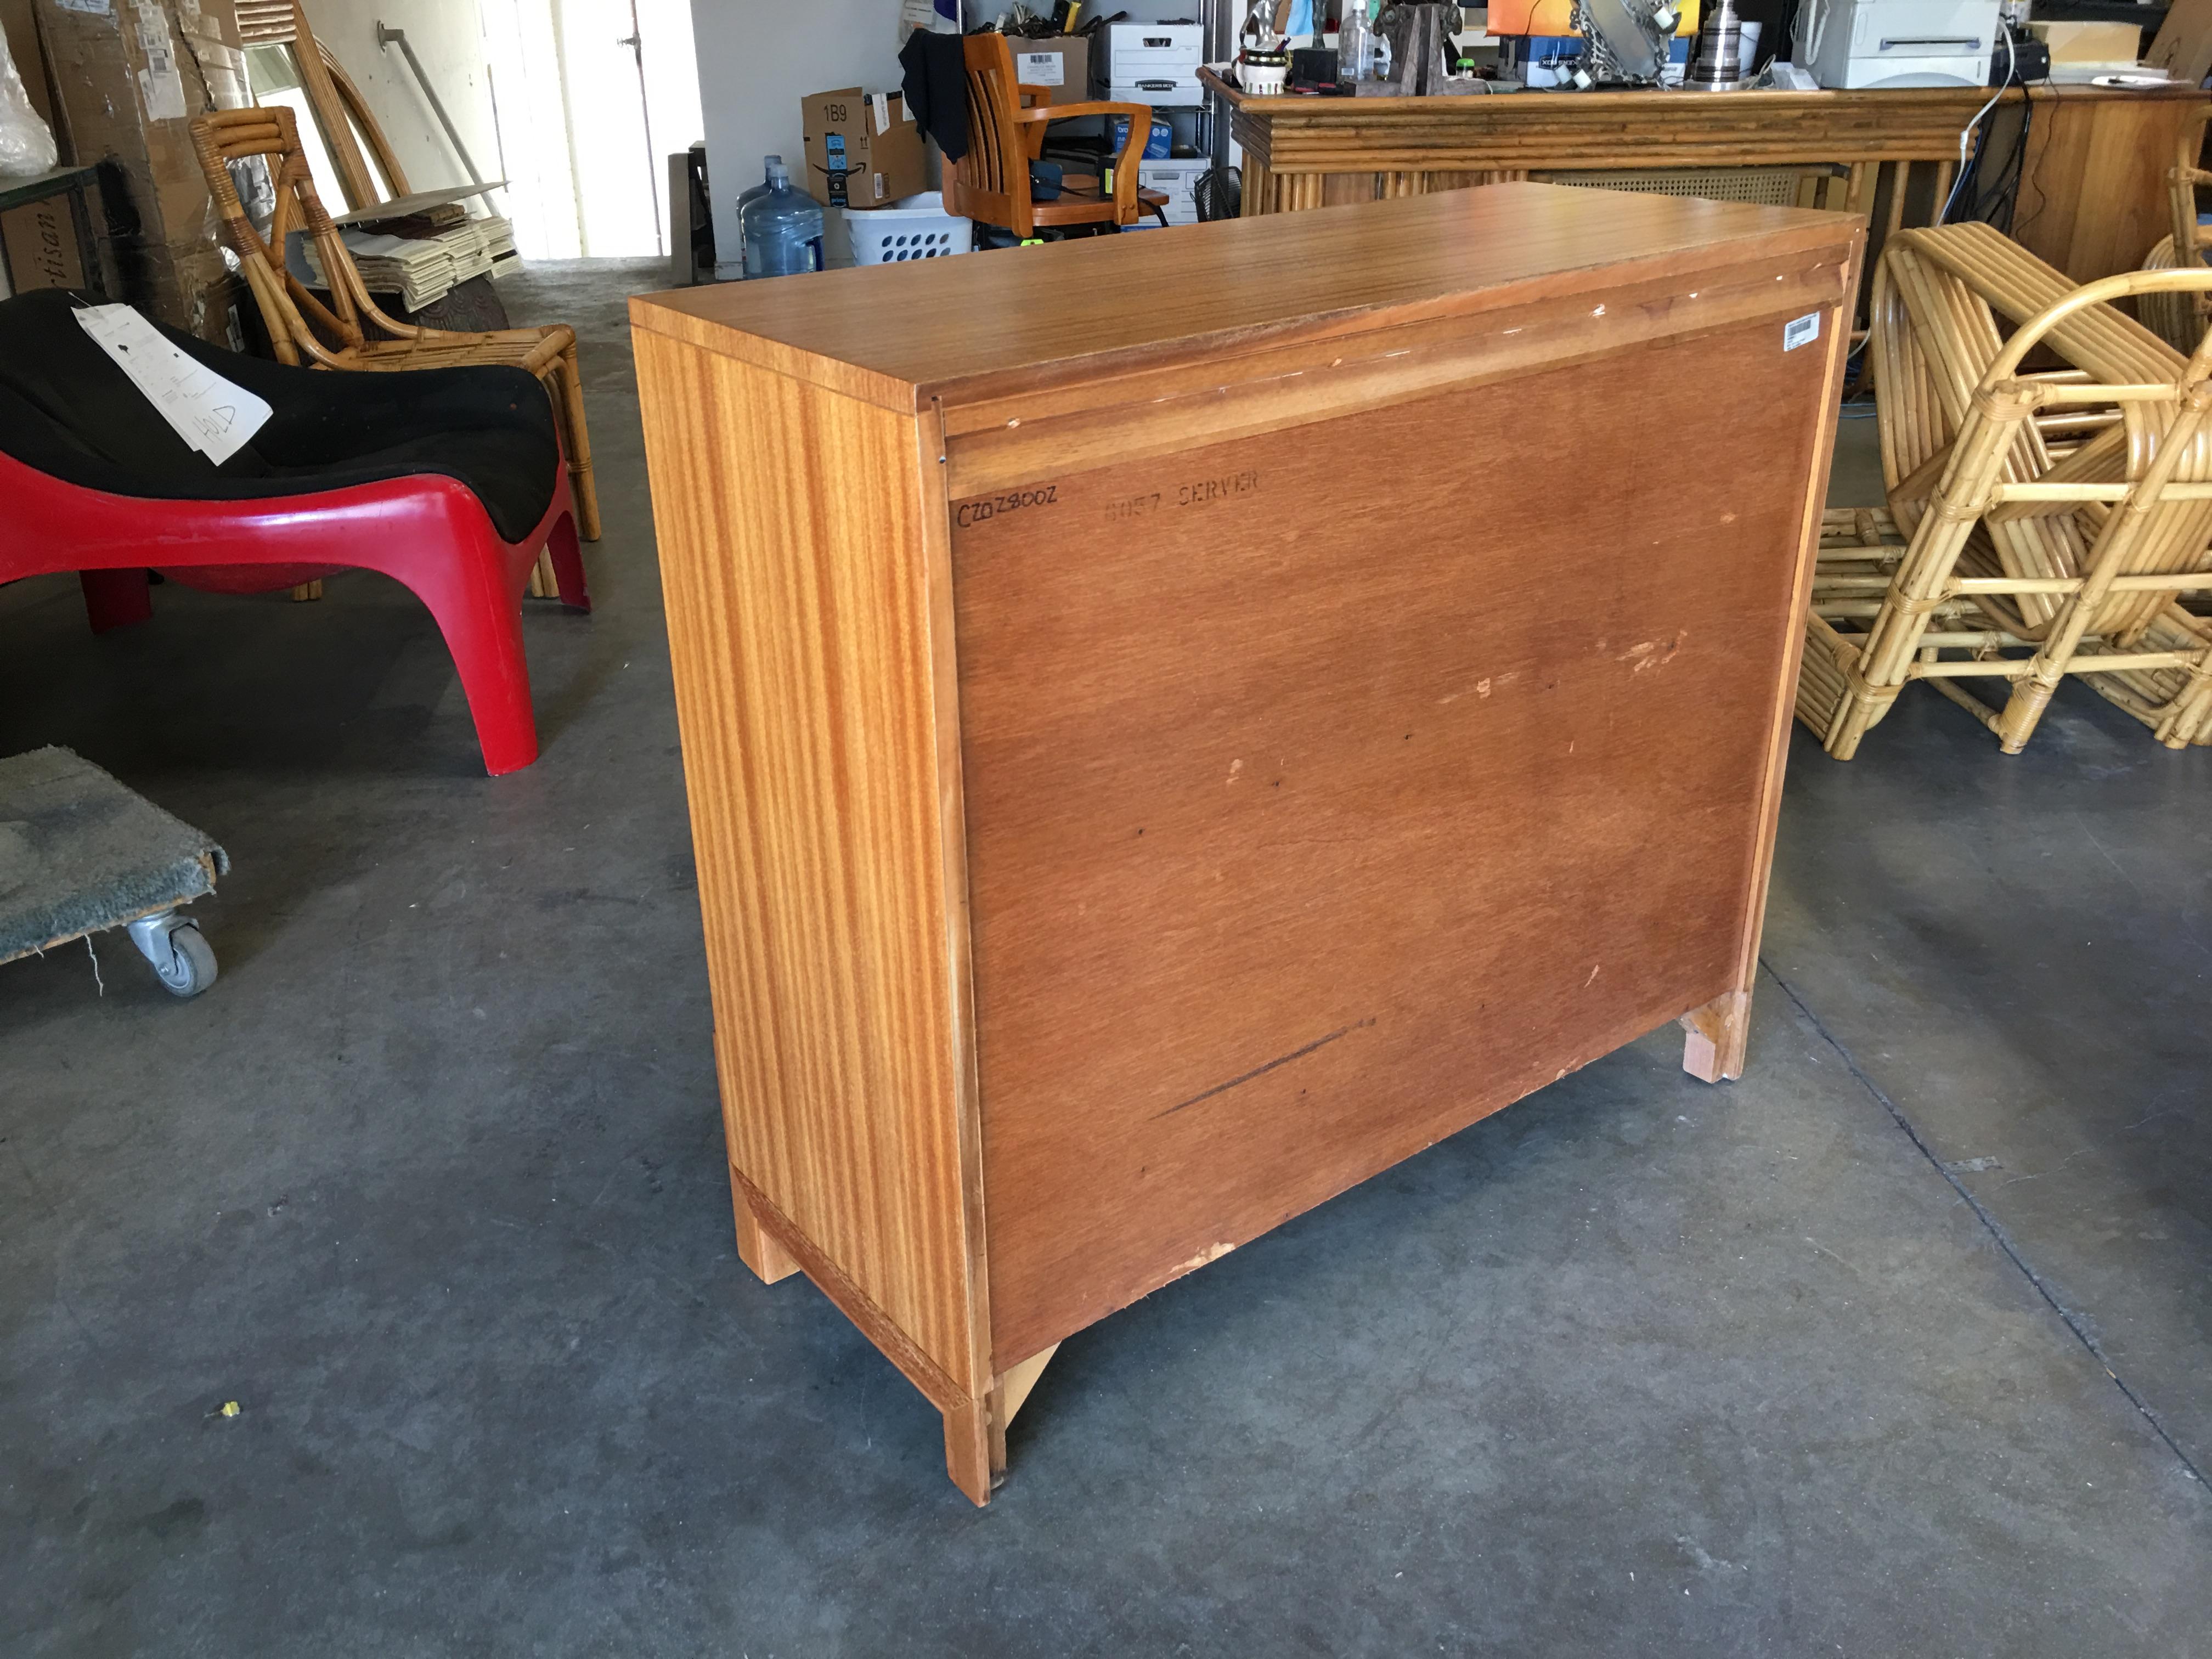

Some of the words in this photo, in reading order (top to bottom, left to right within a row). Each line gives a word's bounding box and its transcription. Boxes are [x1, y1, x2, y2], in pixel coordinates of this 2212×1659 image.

[824, 104, 847, 122] 1B9
[192, 405, 235, 443] HOLD
[1180, 470, 1259, 506] SERVER
